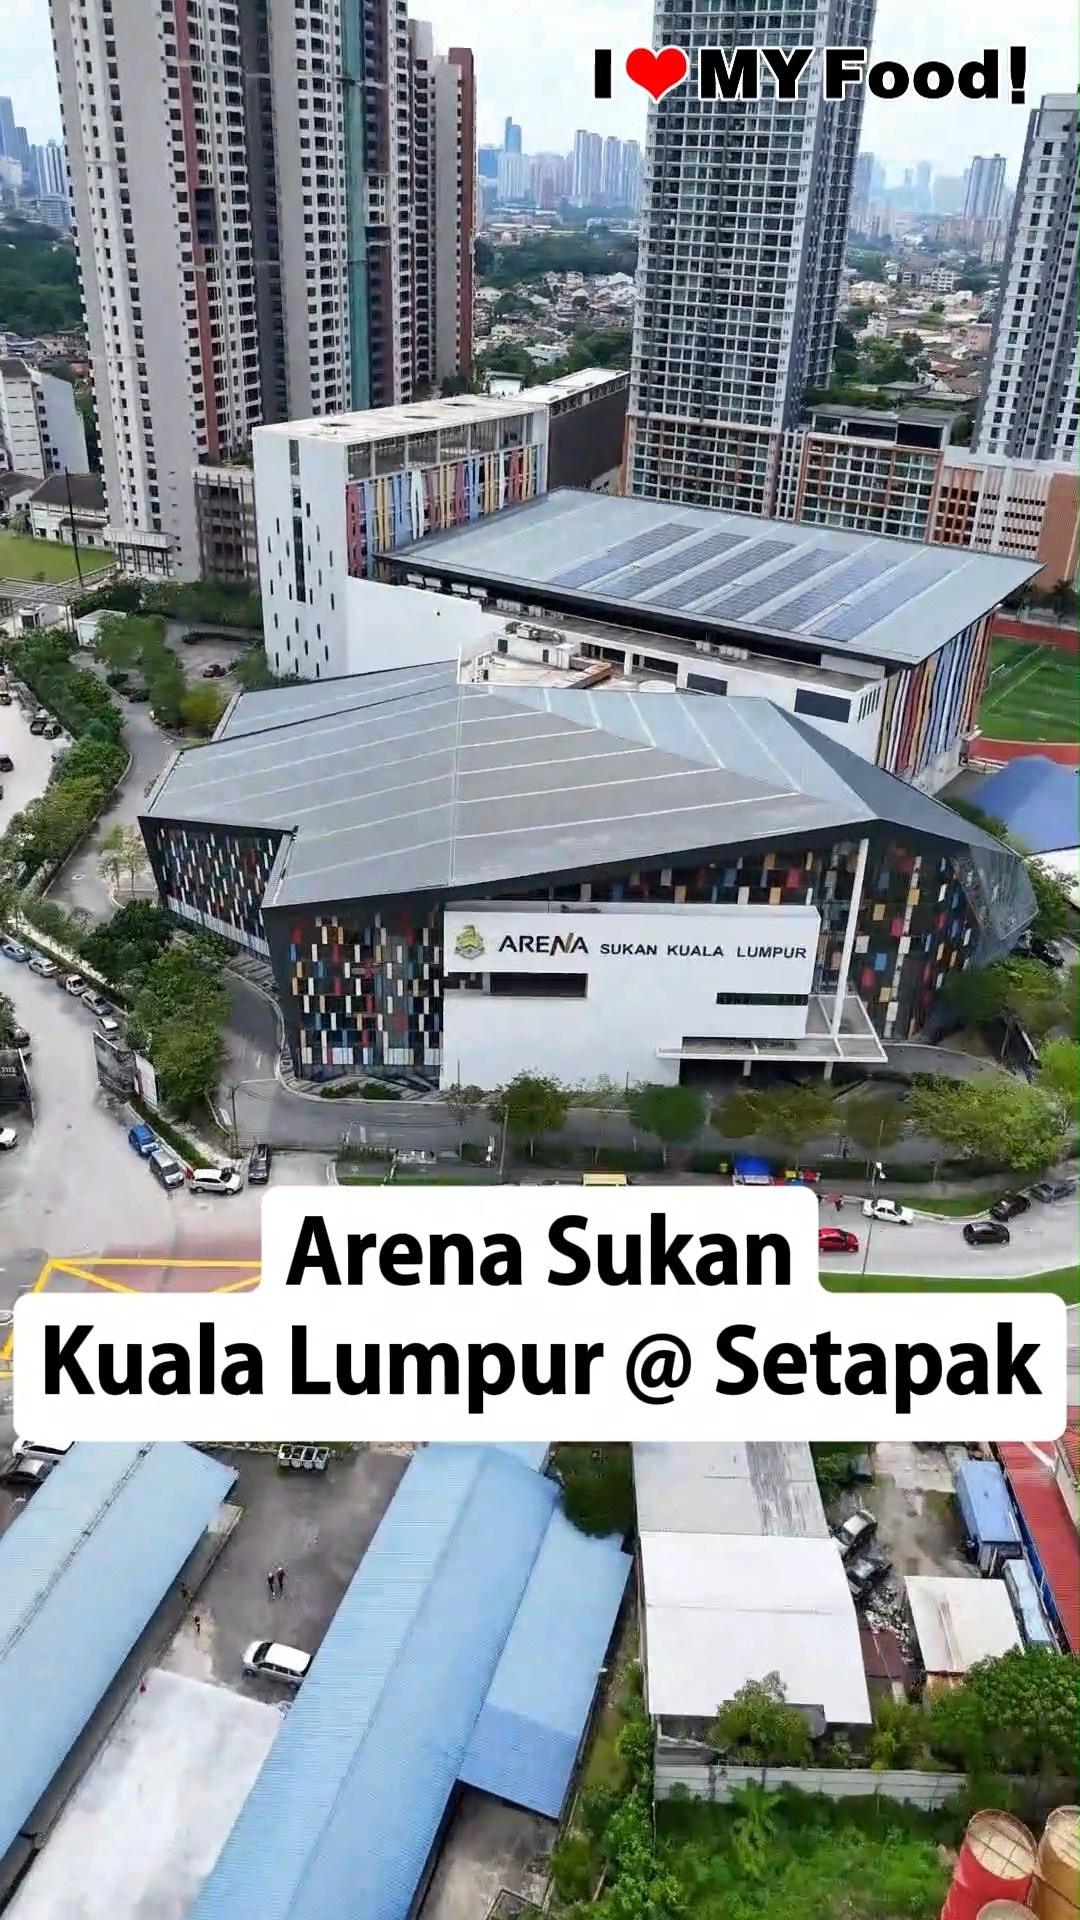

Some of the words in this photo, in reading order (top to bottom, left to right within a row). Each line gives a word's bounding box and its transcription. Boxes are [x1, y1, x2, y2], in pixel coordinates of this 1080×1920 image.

[499, 932, 589, 956] ARENA
[600, 943, 658, 956] SUKAN
[667, 944, 724, 957] KUALA
[737, 946, 807, 959] LUMPUR
